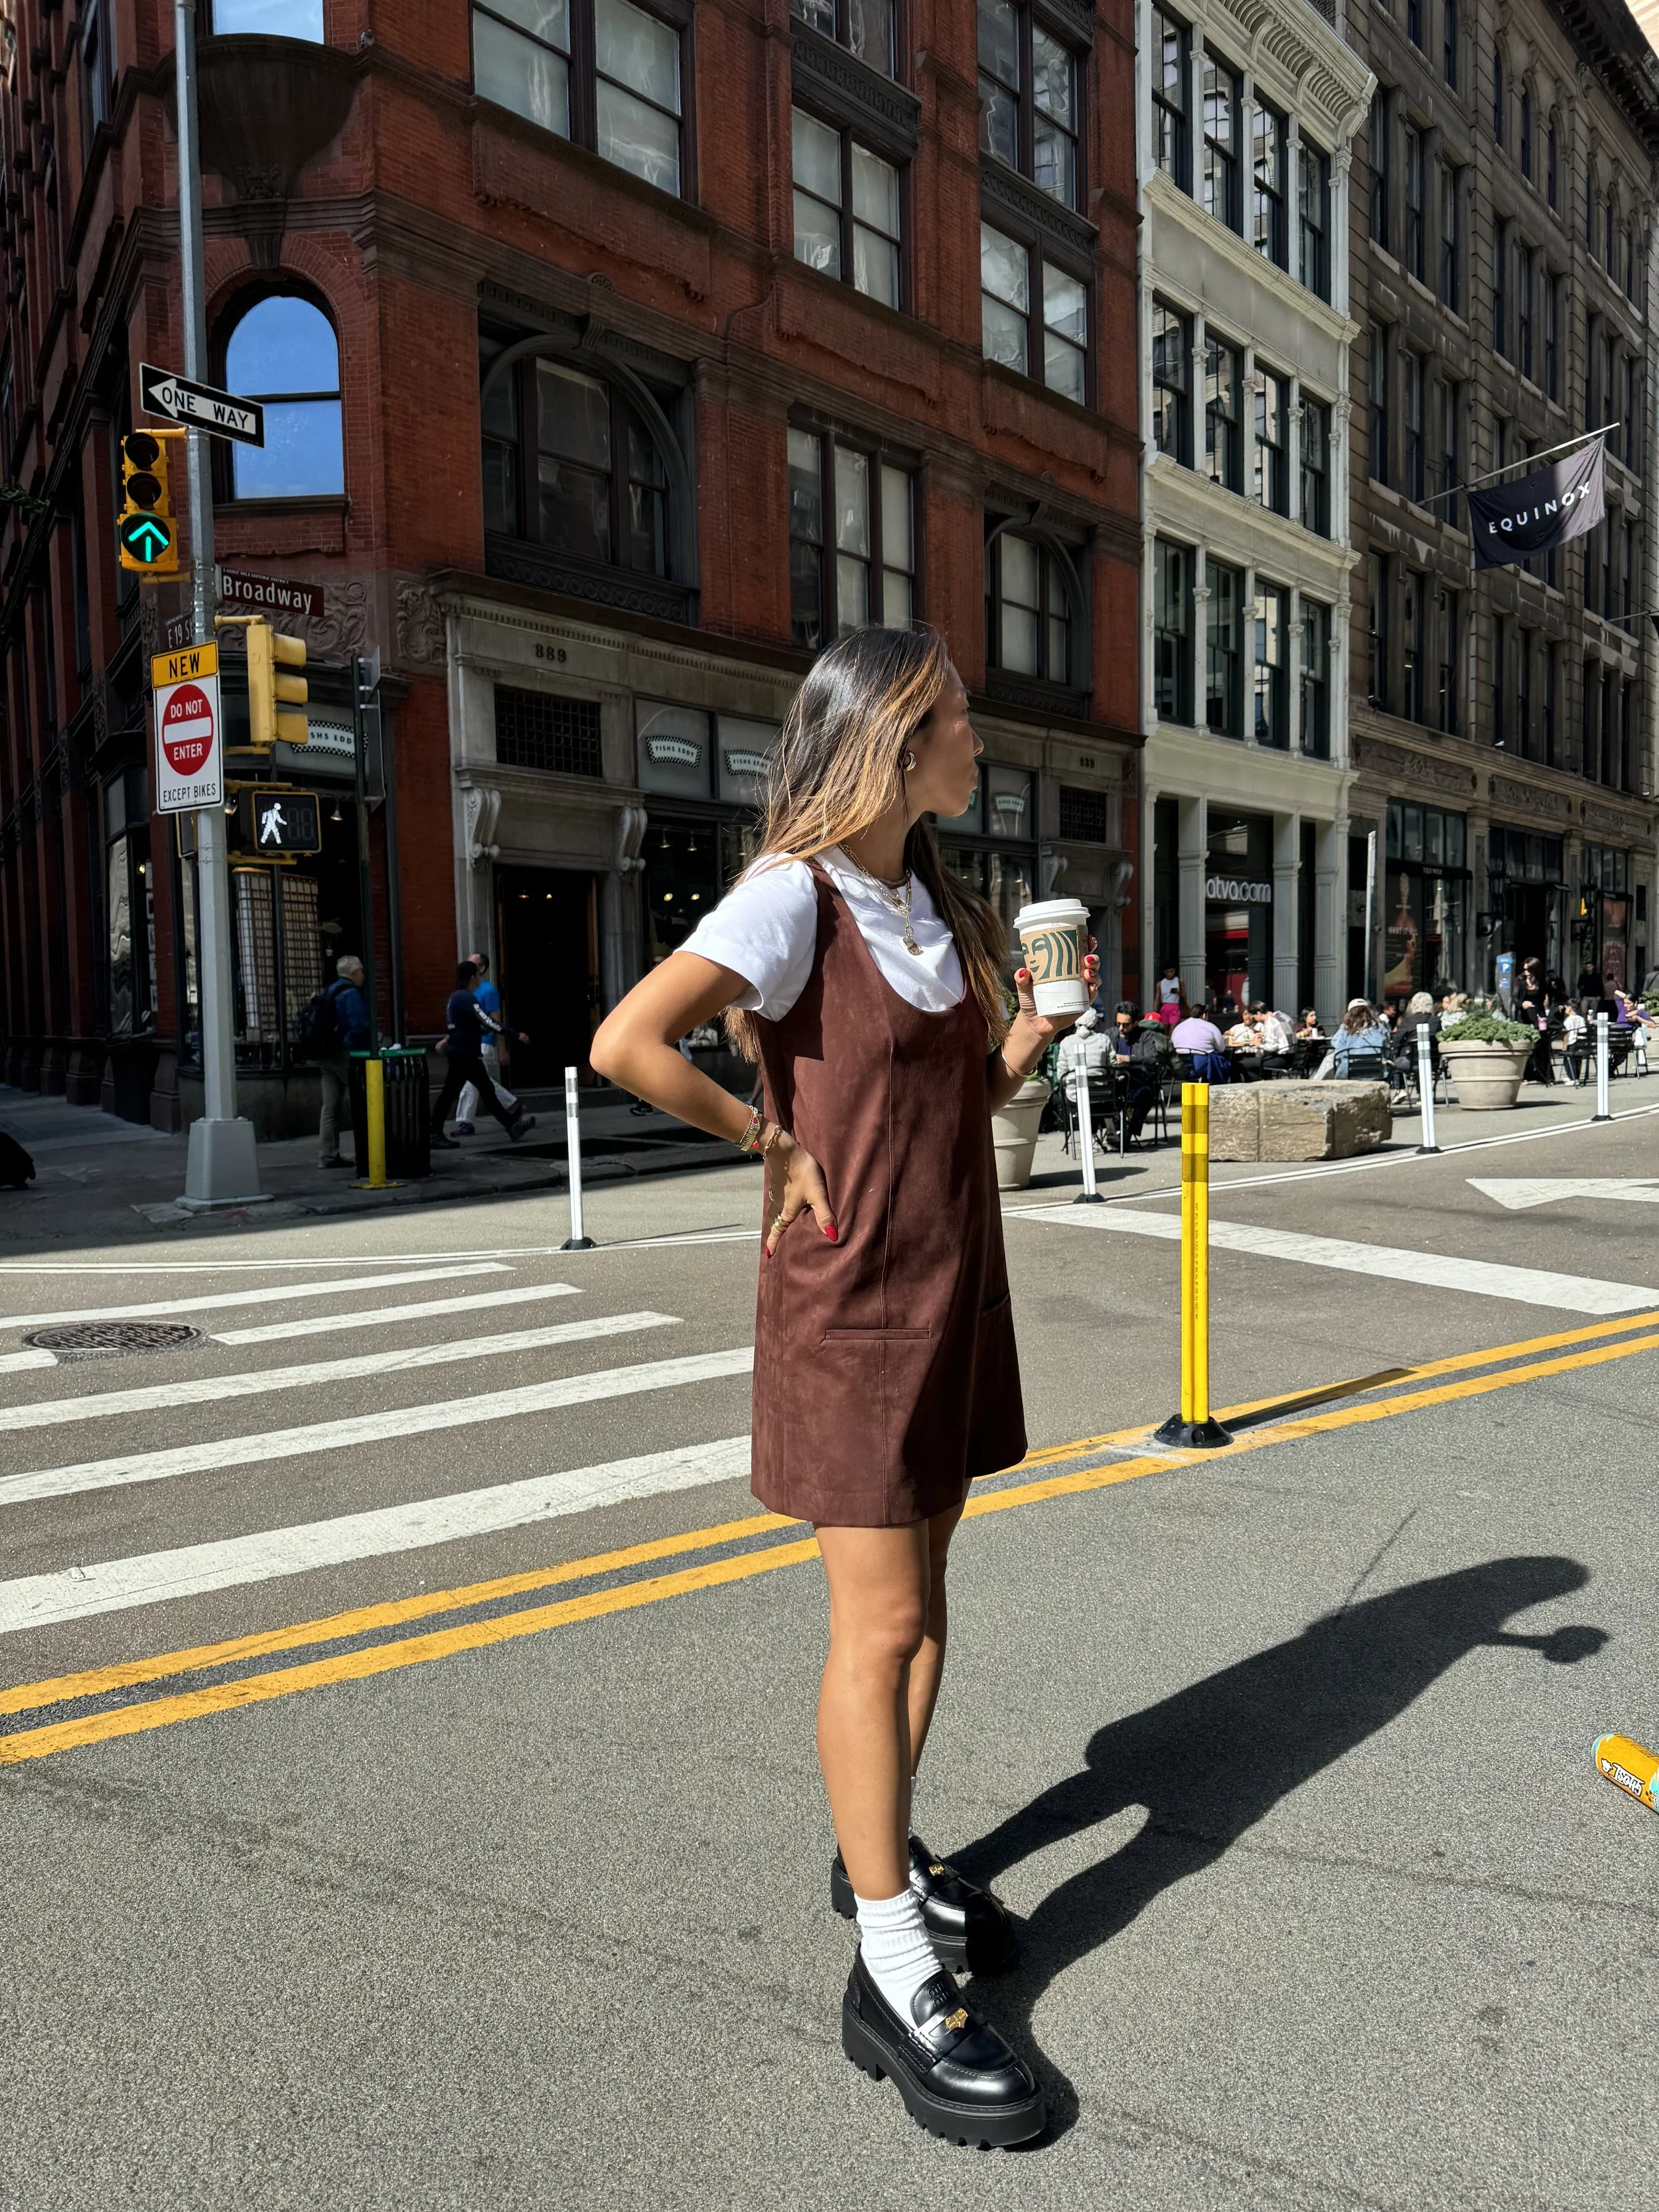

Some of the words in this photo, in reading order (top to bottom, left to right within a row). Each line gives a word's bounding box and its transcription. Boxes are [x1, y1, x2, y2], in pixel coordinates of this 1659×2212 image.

[162, 387, 196, 413] ONE
[213, 404, 249, 429] WAY
[1488, 481, 1590, 534] EQUINOX
[222, 575, 312, 615] Broadway
[168, 628, 173, 649] E
[174, 623, 183, 646] 19
[169, 652, 200, 679] NEW
[536, 644, 566, 662] 889
[171, 703, 182, 719] DO
[185, 699, 203, 715] NOT
[311, 731, 328, 740] SHS
[334, 735, 352, 744] EDD
[174, 743, 202, 761] ENTER
[163, 786, 190, 802] EXCEPT
[194, 783, 216, 798] BIKES
[1206, 876, 1271, 903] atva.com
